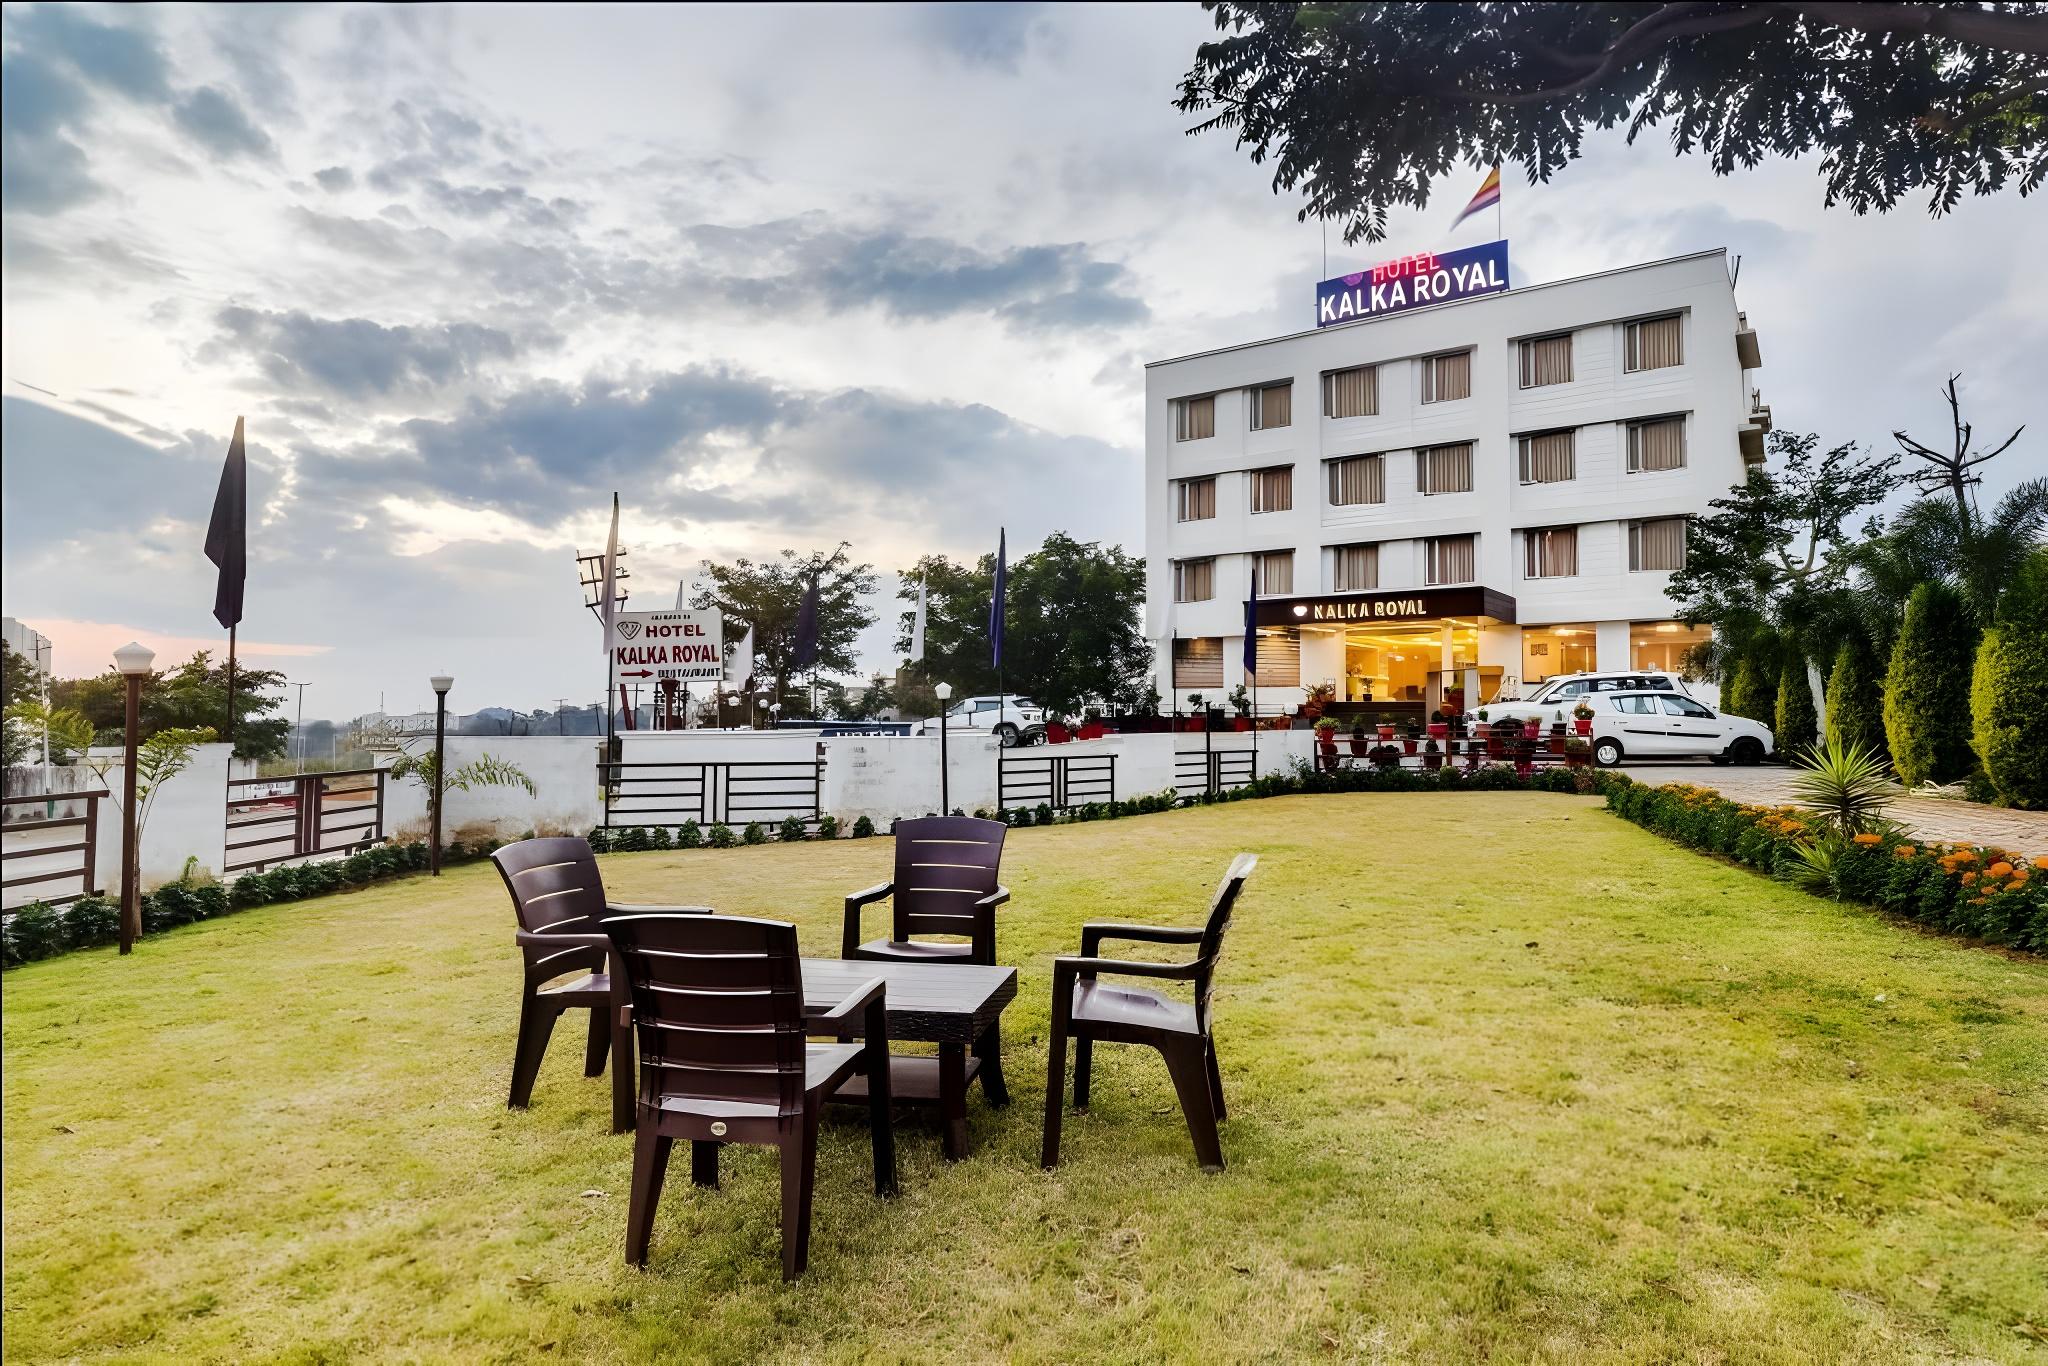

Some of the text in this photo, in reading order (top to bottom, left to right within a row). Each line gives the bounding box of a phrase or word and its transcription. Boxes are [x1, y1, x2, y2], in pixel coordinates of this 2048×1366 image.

[1372, 252, 1440, 282] HOTEL
[1320, 259, 1505, 323] KALKA ROYAL
[1374, 599, 1428, 617] ROYAL
[645, 624, 706, 638] HOTEL
[616, 644, 720, 666] KALKA ROYAL
